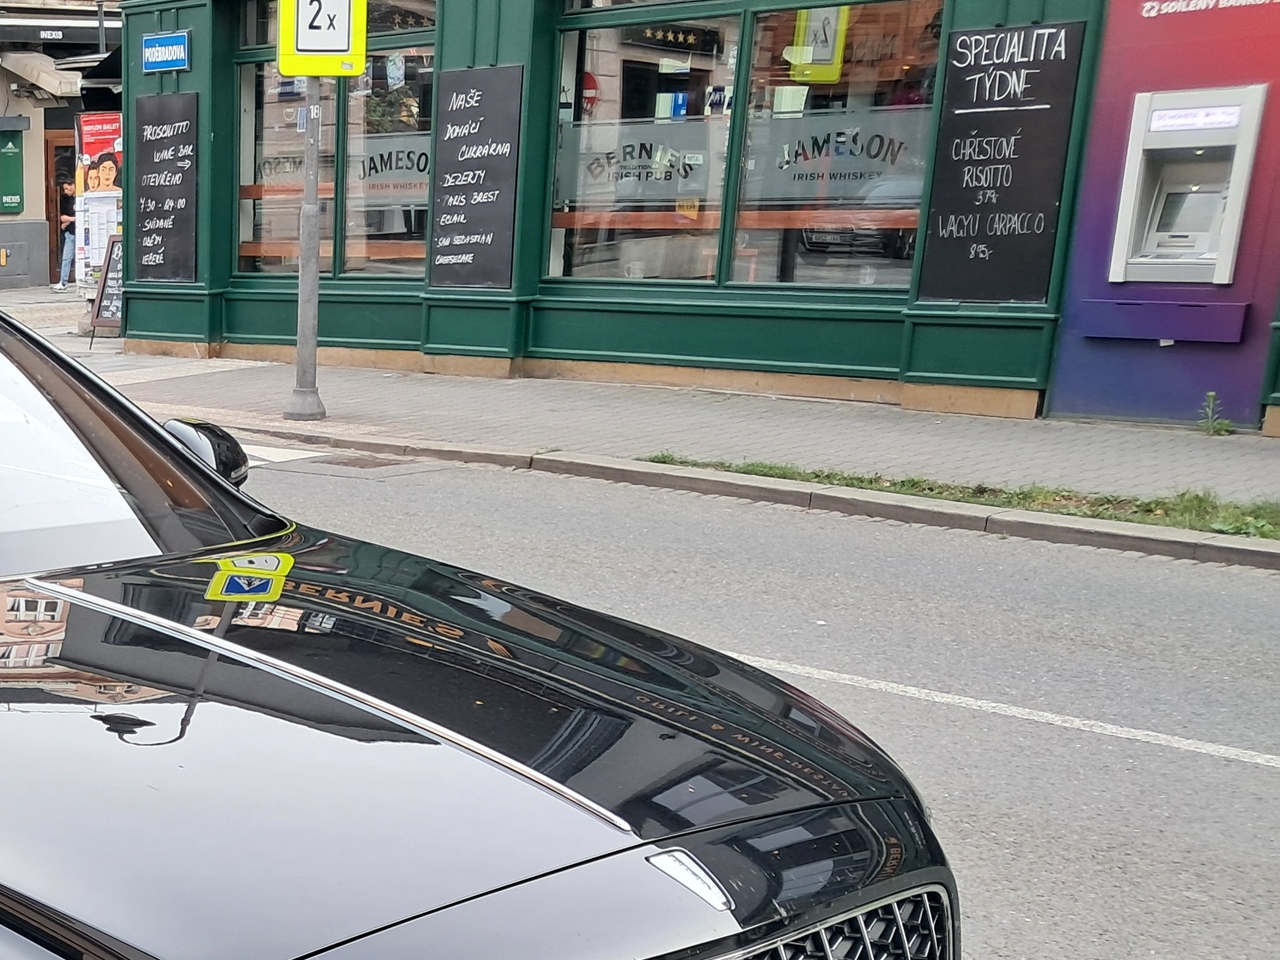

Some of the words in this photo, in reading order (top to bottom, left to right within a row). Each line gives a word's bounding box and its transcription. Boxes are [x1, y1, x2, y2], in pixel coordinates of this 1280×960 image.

[308, 0, 322, 31] 2
[40, 30, 63, 40] INEXIS
[144, 43, 186, 64] PODĚBRADOVA
[950, 28, 1067, 68] SPECIALITA
[965, 66, 1041, 103] TÝDNE
[448, 88, 483, 112] NAŠE
[309, 105, 320, 120] 18
[142, 120, 190, 143] PROSCIUTTO
[457, 138, 511, 161] CUKRÁRNA
[777, 129, 905, 170] JAMESON
[952, 127, 1023, 161] CHŘESTOVÉ
[358, 150, 431, 180] JAMESO
[608, 171, 642, 182] IRISH
[645, 171, 673, 182] PUB
[793, 172, 825, 182] IRISH
[828, 171, 883, 181] WHISKEY
[962, 164, 1013, 188] RISOTTO
[368, 182, 390, 191] IRISH
[470, 190, 500, 204] BREST
[939, 213, 980, 239] WAGYU
